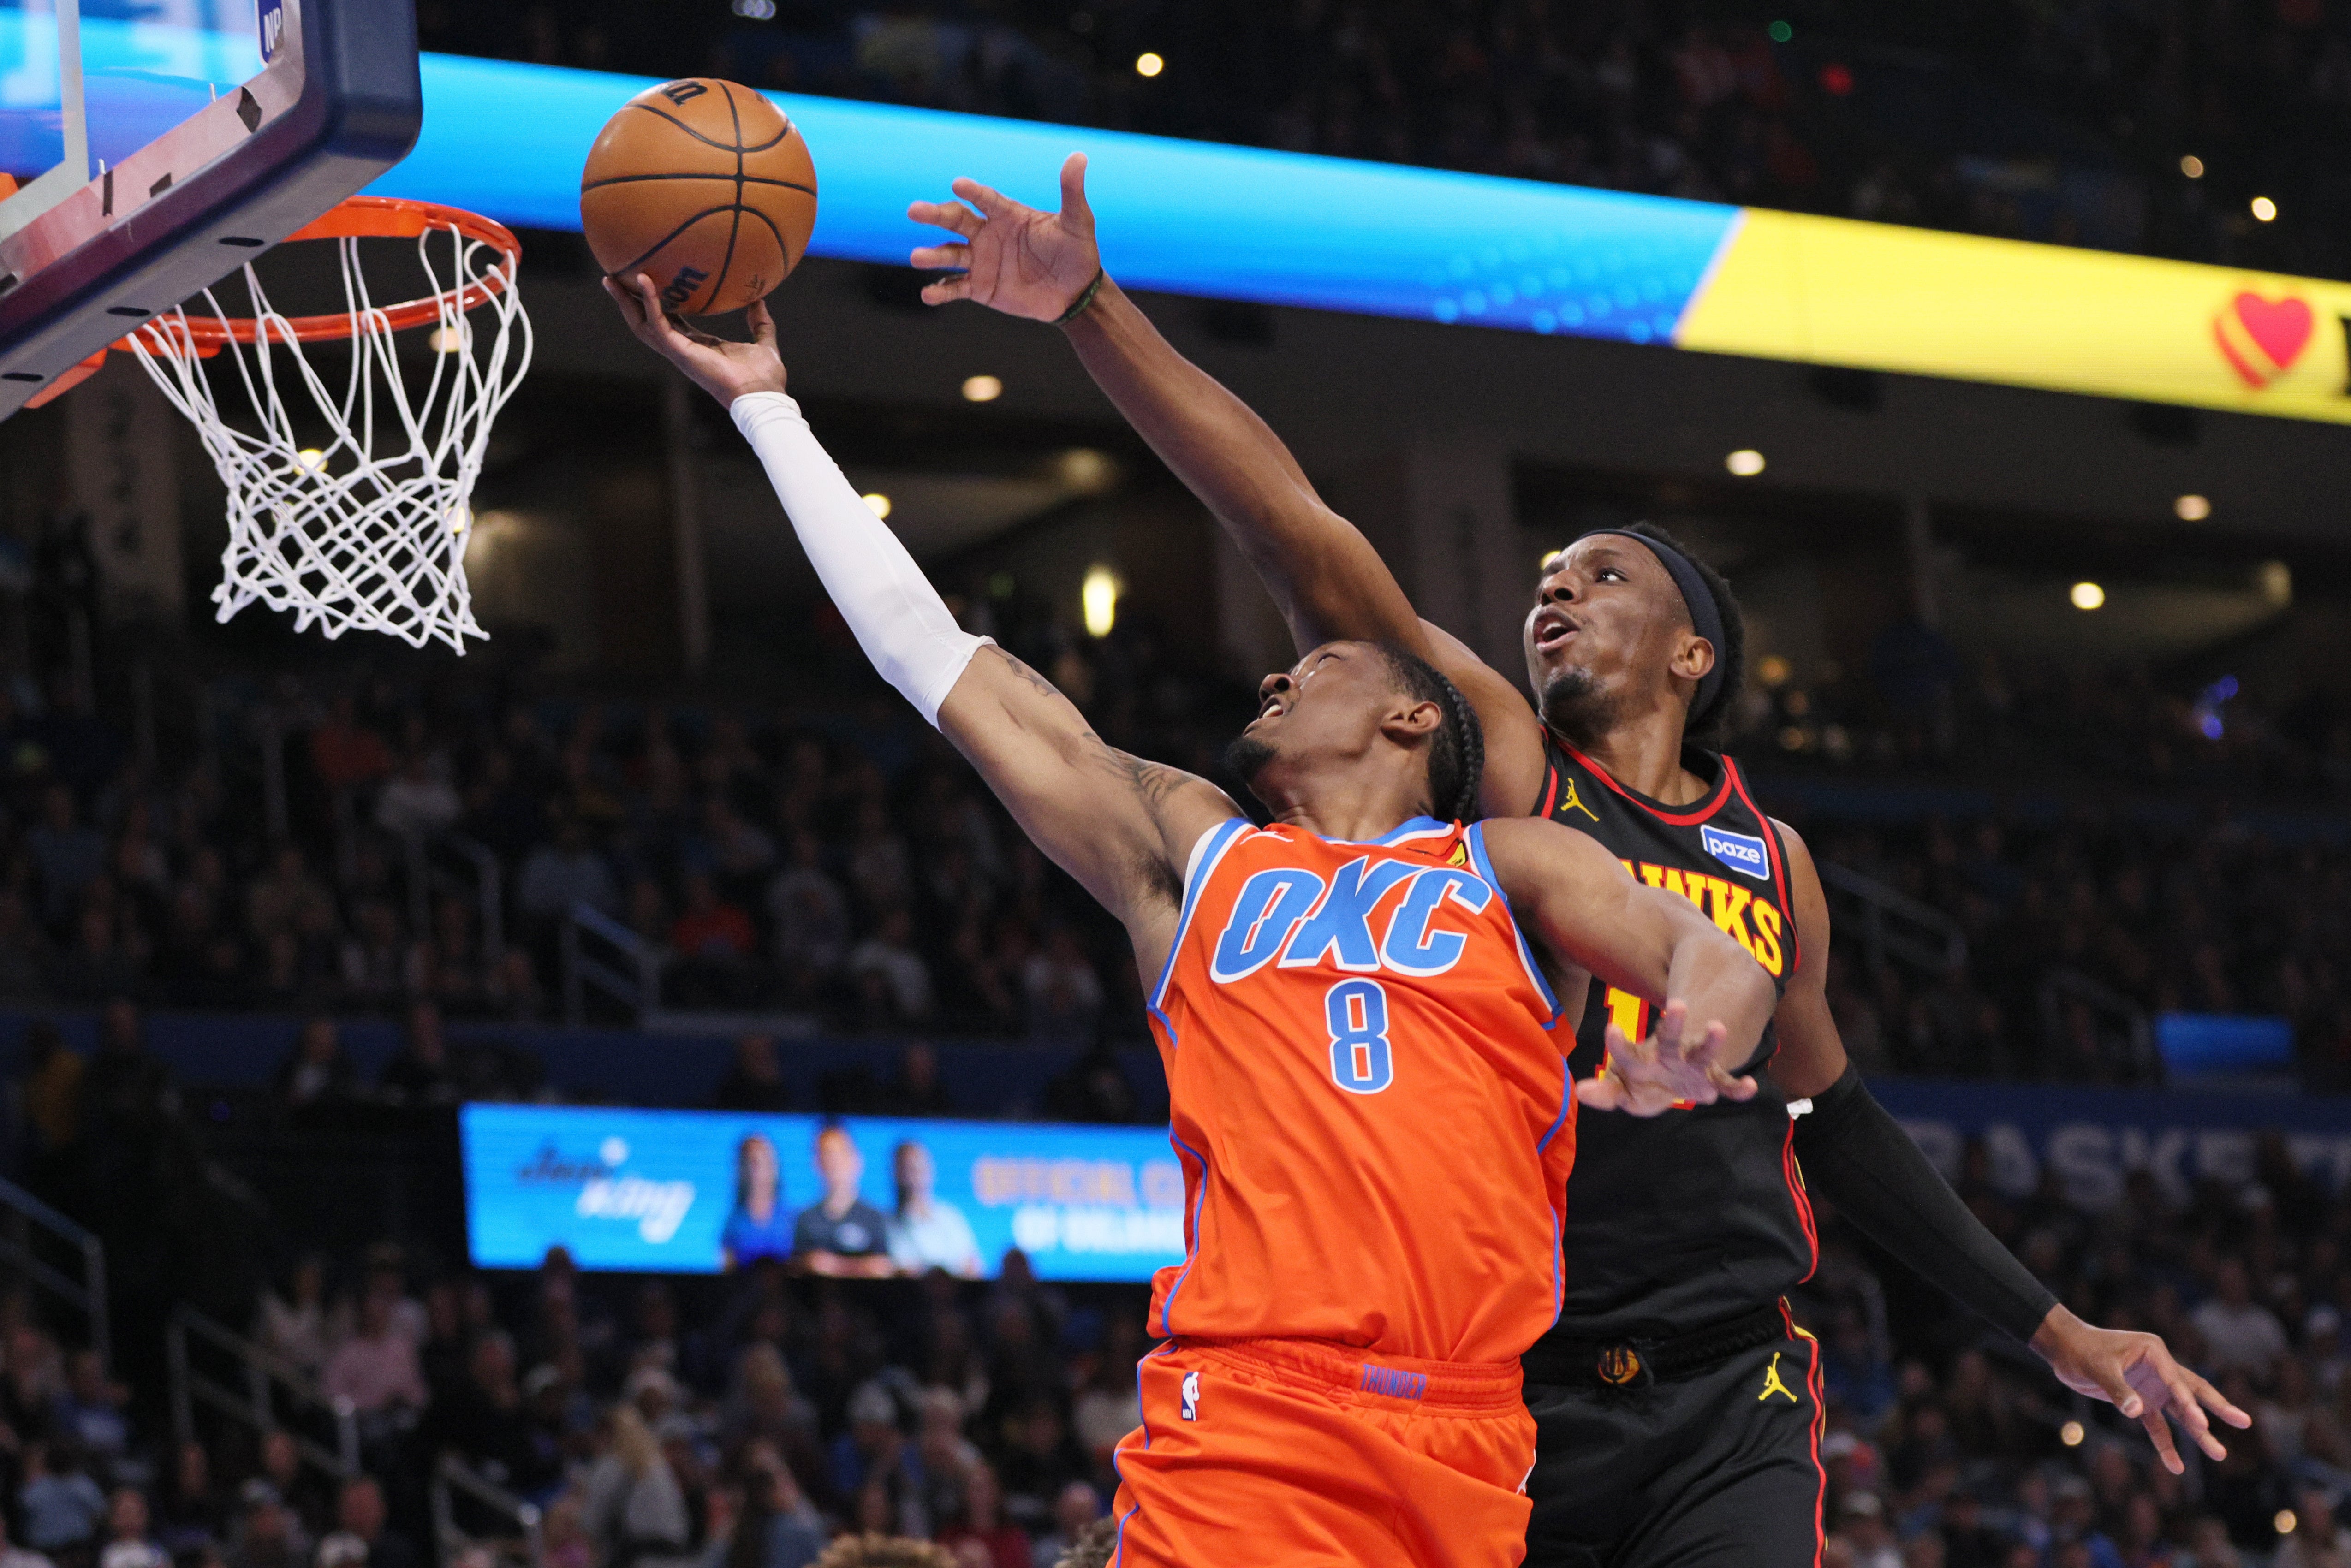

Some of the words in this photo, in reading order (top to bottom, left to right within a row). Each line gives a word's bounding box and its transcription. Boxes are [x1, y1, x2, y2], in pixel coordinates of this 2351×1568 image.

[1708, 837, 1762, 864] paze
[1210, 854, 1493, 984] OKC
[1325, 977, 1393, 1095] 8
[1360, 1363, 1427, 1400] THUNDER
